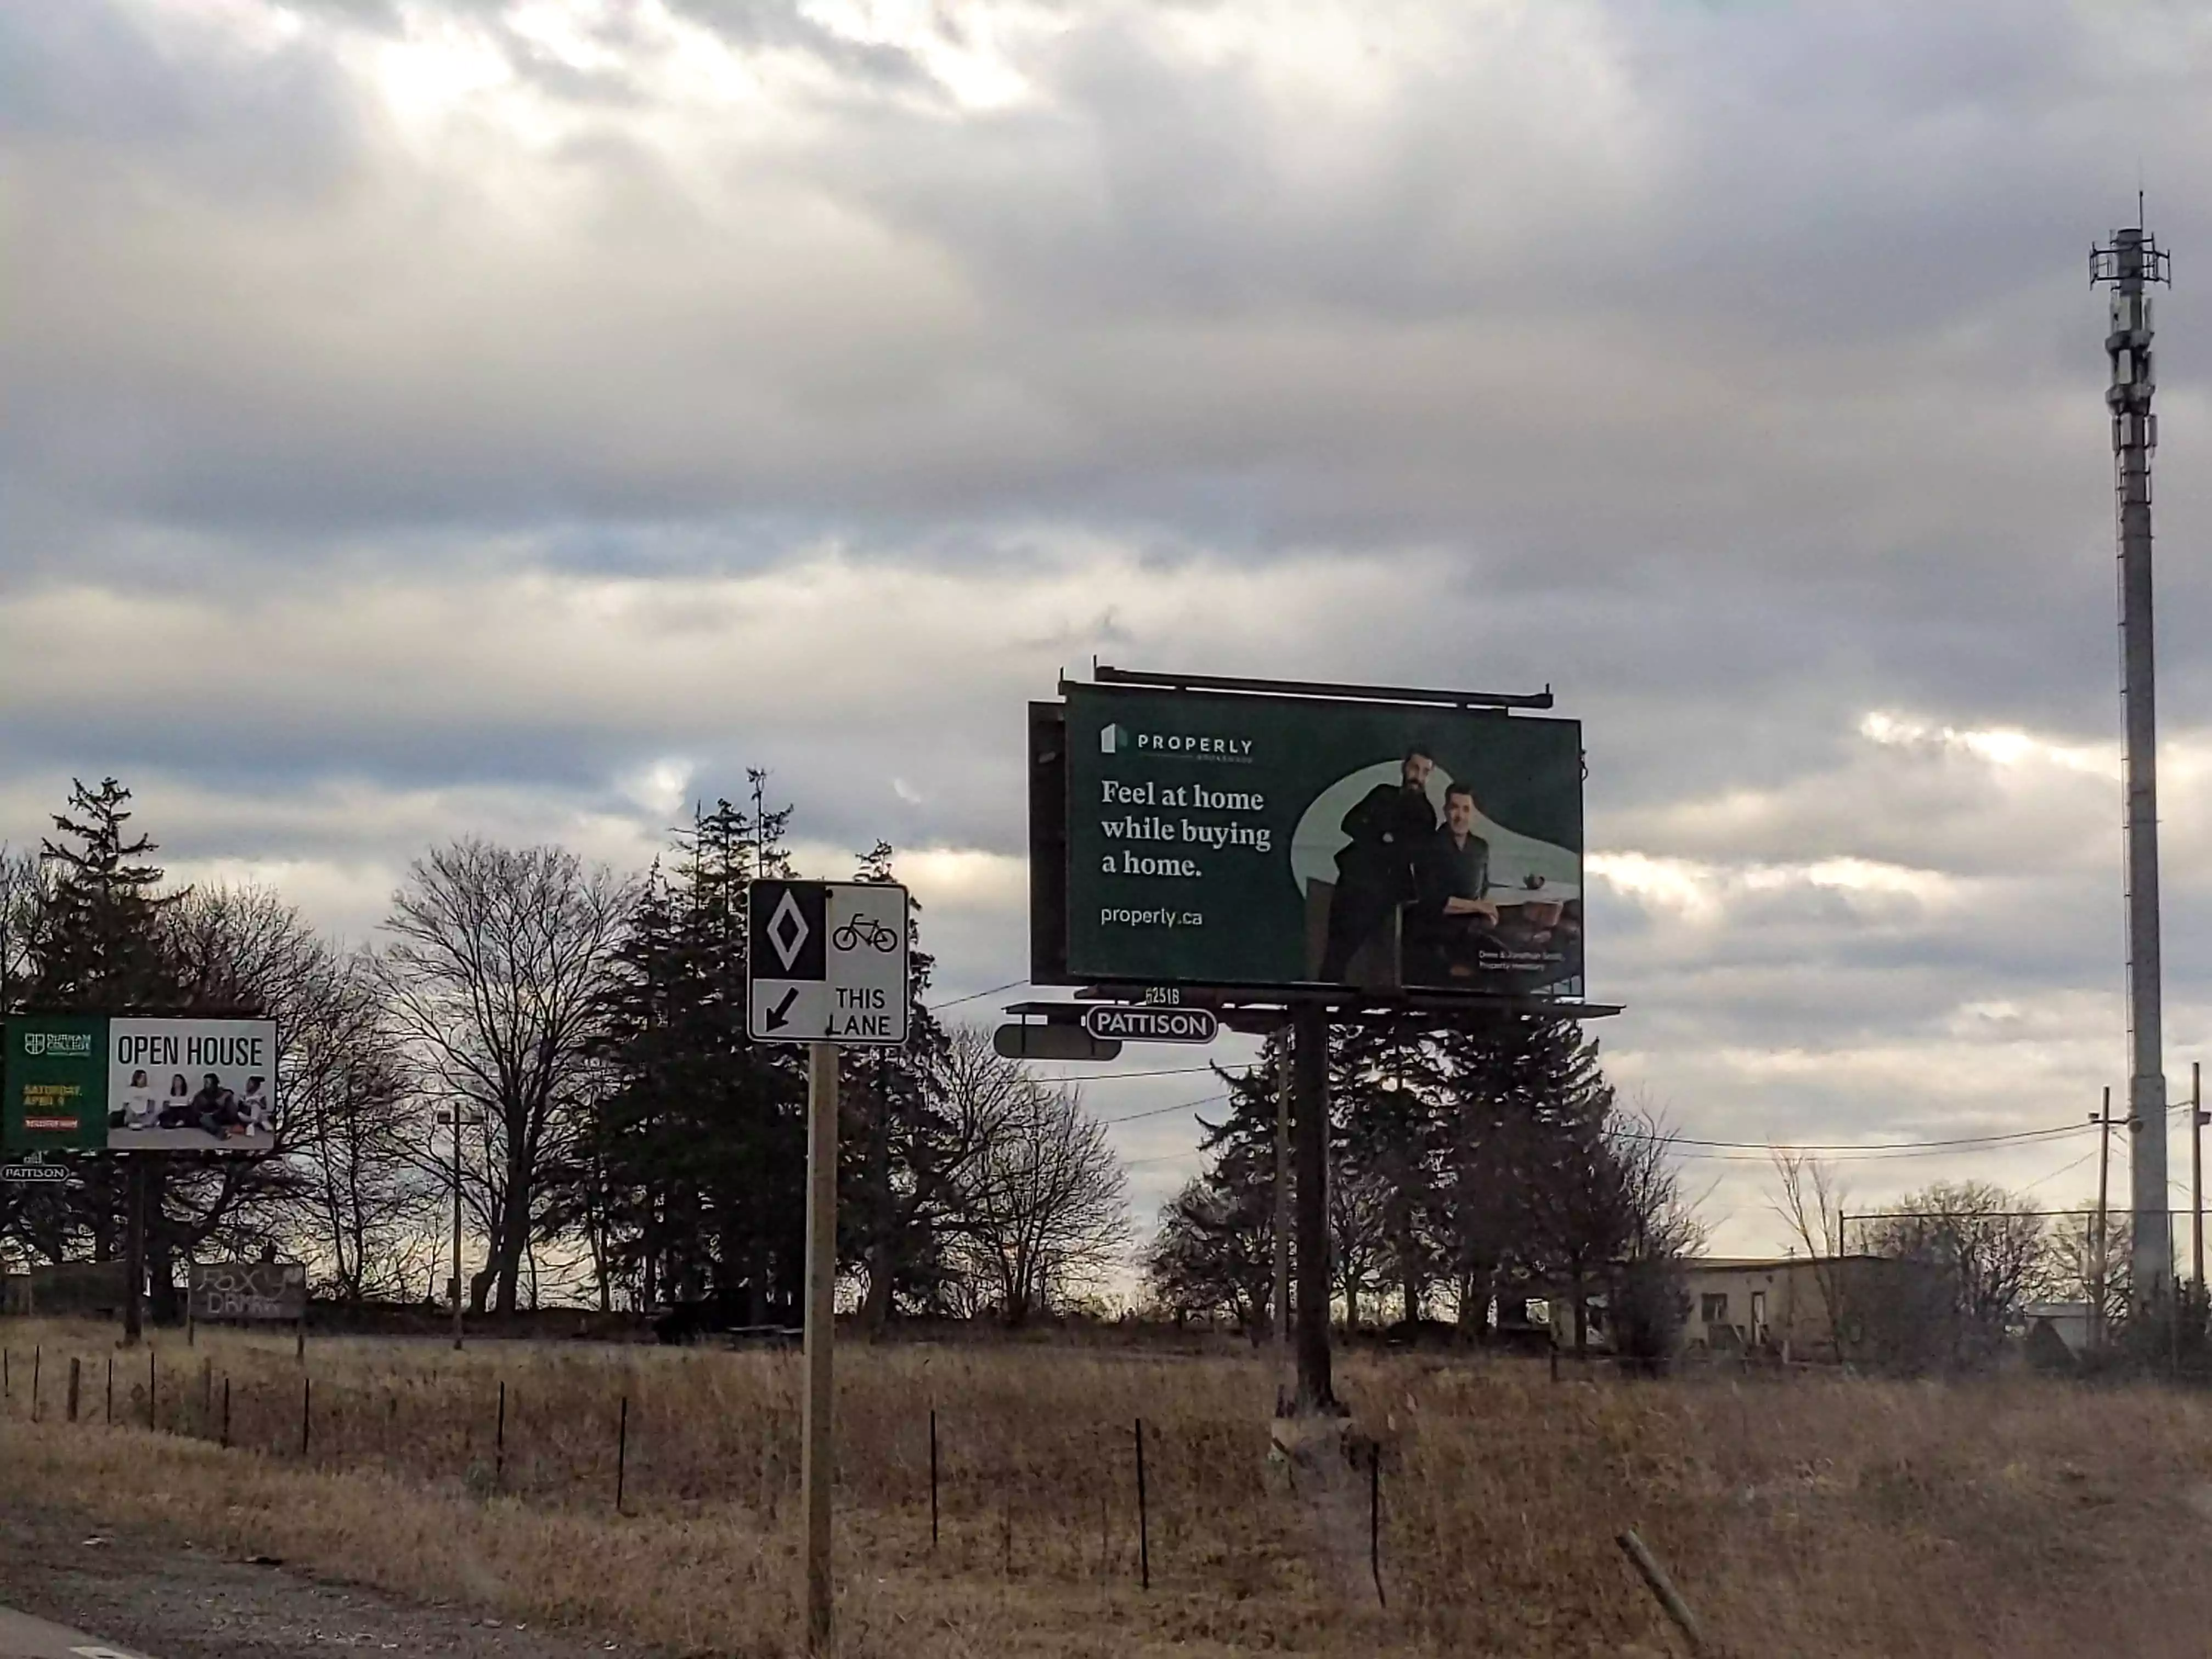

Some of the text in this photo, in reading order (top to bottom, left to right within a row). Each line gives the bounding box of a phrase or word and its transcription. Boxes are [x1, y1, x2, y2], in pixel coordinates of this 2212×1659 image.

[1138, 733, 1253, 755] PROPERLY
[1102, 780, 1265, 810] Feel at home
[1101, 816, 1272, 852] while buying
[1102, 850, 1203, 877] a home.
[1101, 907, 1203, 928] properly.ca
[835, 988, 885, 1009] THIS
[828, 1012, 891, 1036] LANE
[1097, 1012, 1207, 1036] PATTISON
[117, 1035, 263, 1066] OPEN HOUSE
[5, 1168, 65, 1178] PATTISON
